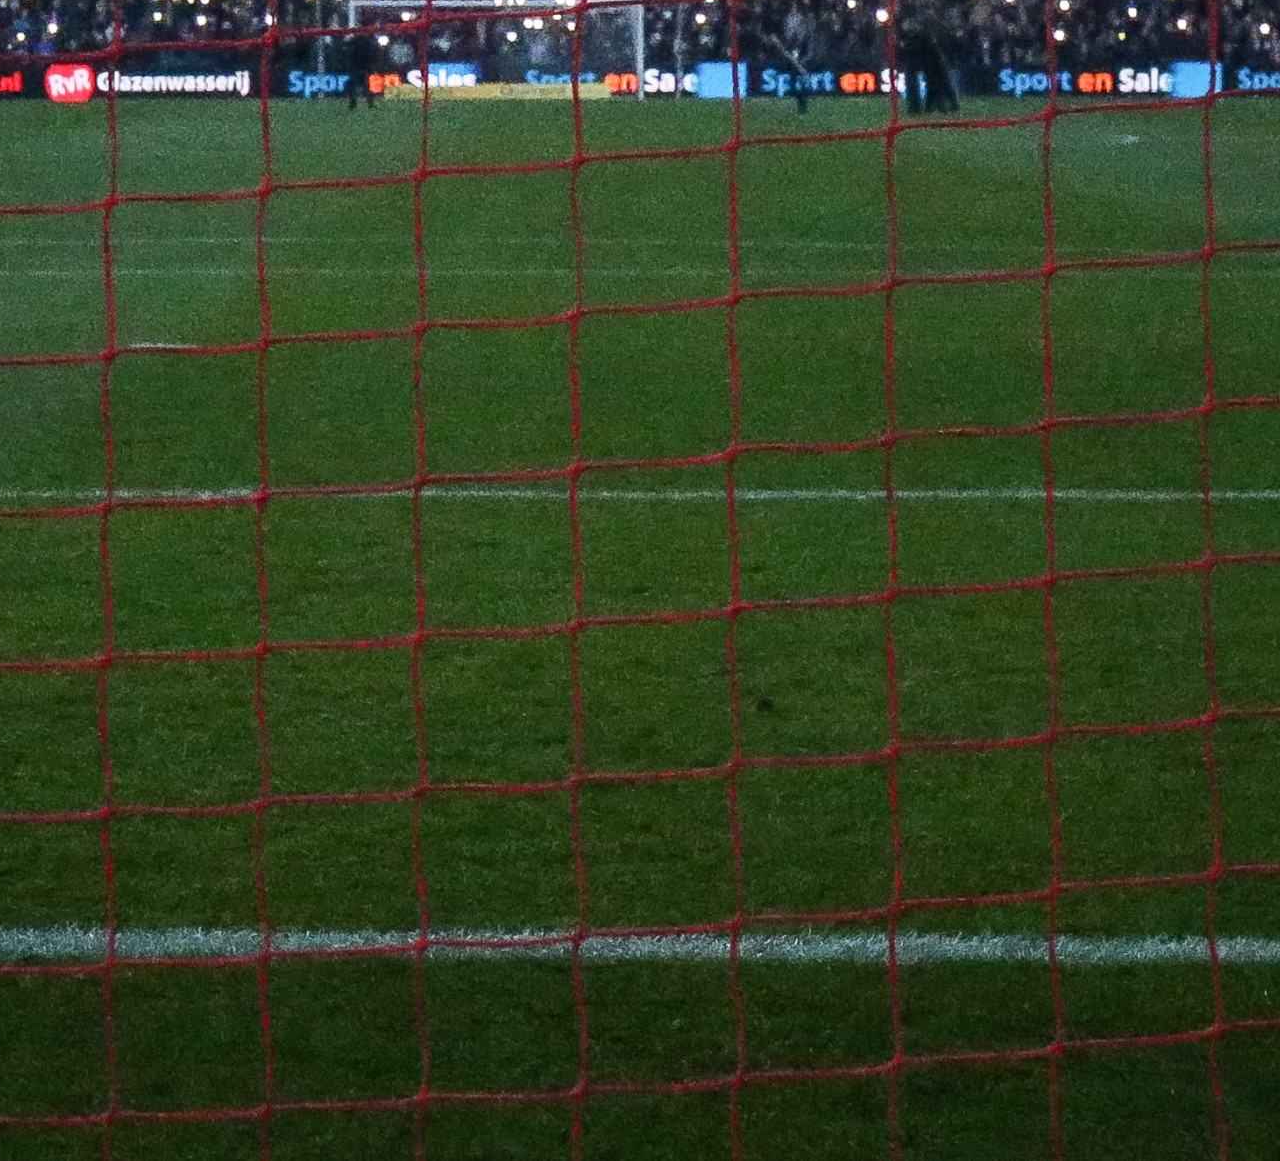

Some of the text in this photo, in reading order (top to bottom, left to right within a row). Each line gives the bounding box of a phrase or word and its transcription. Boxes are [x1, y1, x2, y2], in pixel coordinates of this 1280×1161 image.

[48, 69, 250, 97] RvR Glazenwasserij
[289, 70, 350, 98] Spor
[368, 73, 402, 94] en
[604, 72, 639, 94] en
[839, 72, 876, 93] en
[1077, 72, 1114, 93] en
